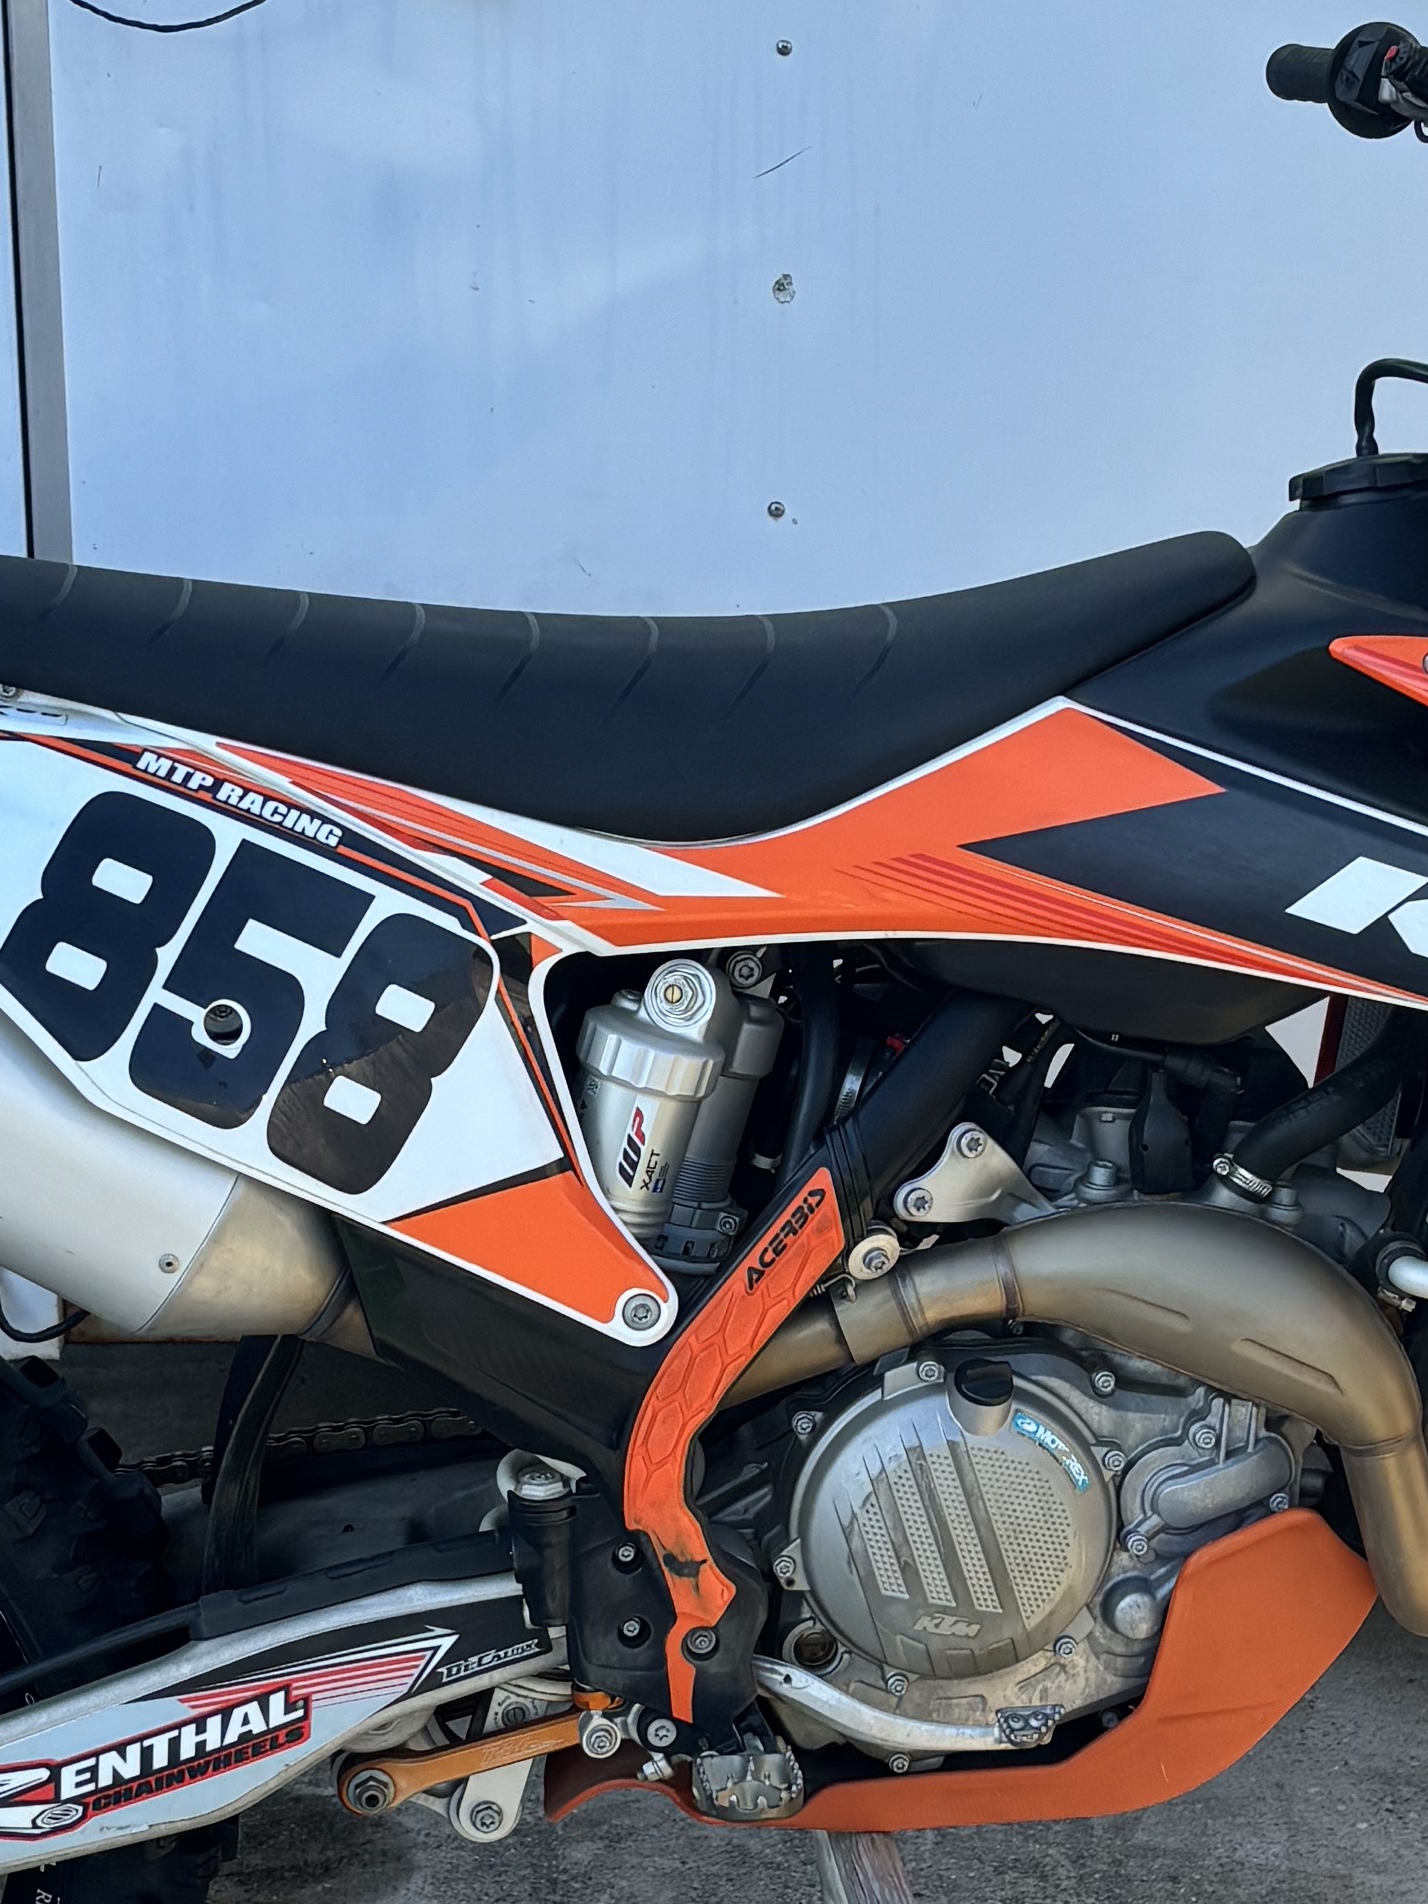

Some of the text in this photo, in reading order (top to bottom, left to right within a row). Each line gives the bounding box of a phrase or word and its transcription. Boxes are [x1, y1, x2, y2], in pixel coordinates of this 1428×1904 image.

[135, 750, 344, 849] MTP RACING
[639, 1148, 661, 1192] XACT
[746, 1188, 826, 1291] ACERBIS
[913, 1612, 981, 1638] KTM
[91, 1729, 304, 1812] CHAINWHEELS
